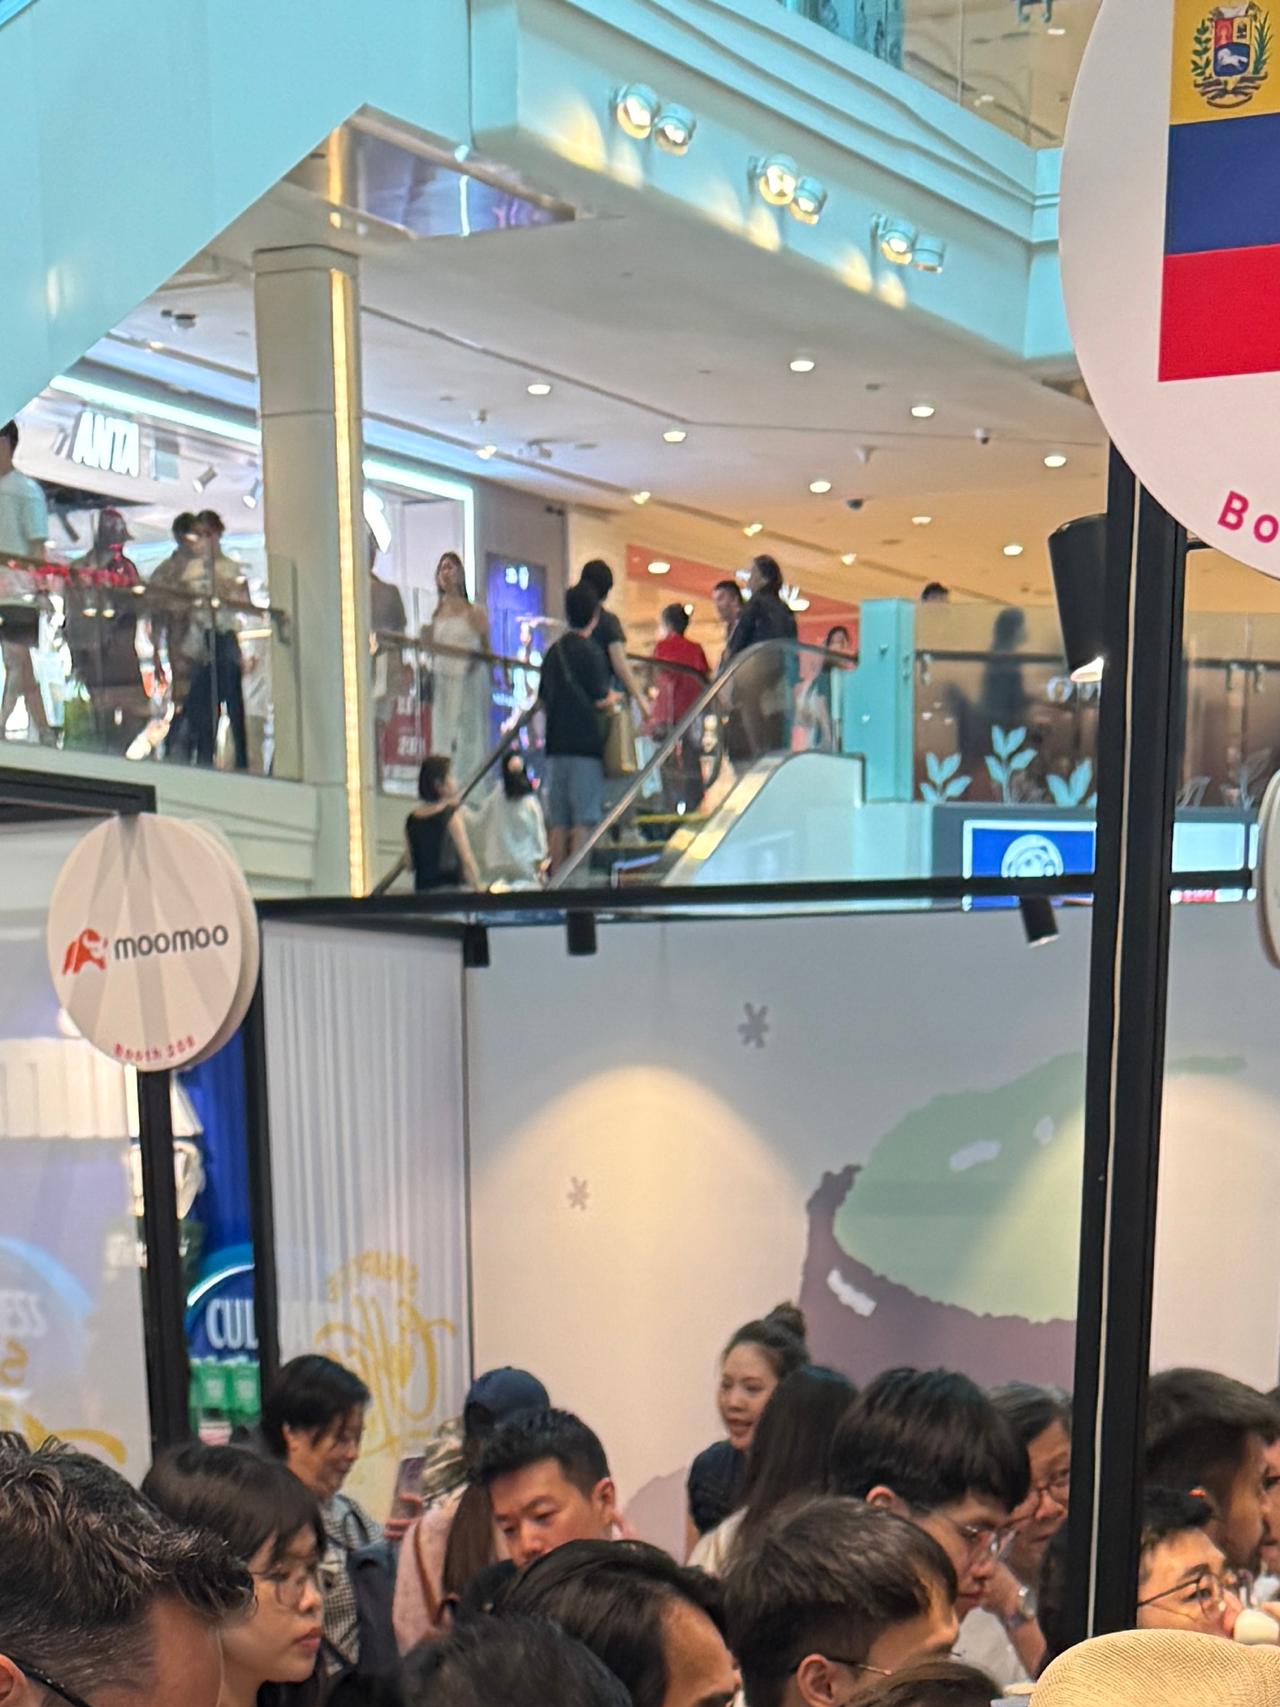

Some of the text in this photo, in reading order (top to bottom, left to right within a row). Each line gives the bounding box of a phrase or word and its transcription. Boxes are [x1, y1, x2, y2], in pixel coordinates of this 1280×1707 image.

[71, 411, 140, 477] ANTA
[114, 924, 229, 960] moomoo
[205, 1297, 259, 1350] CUL
